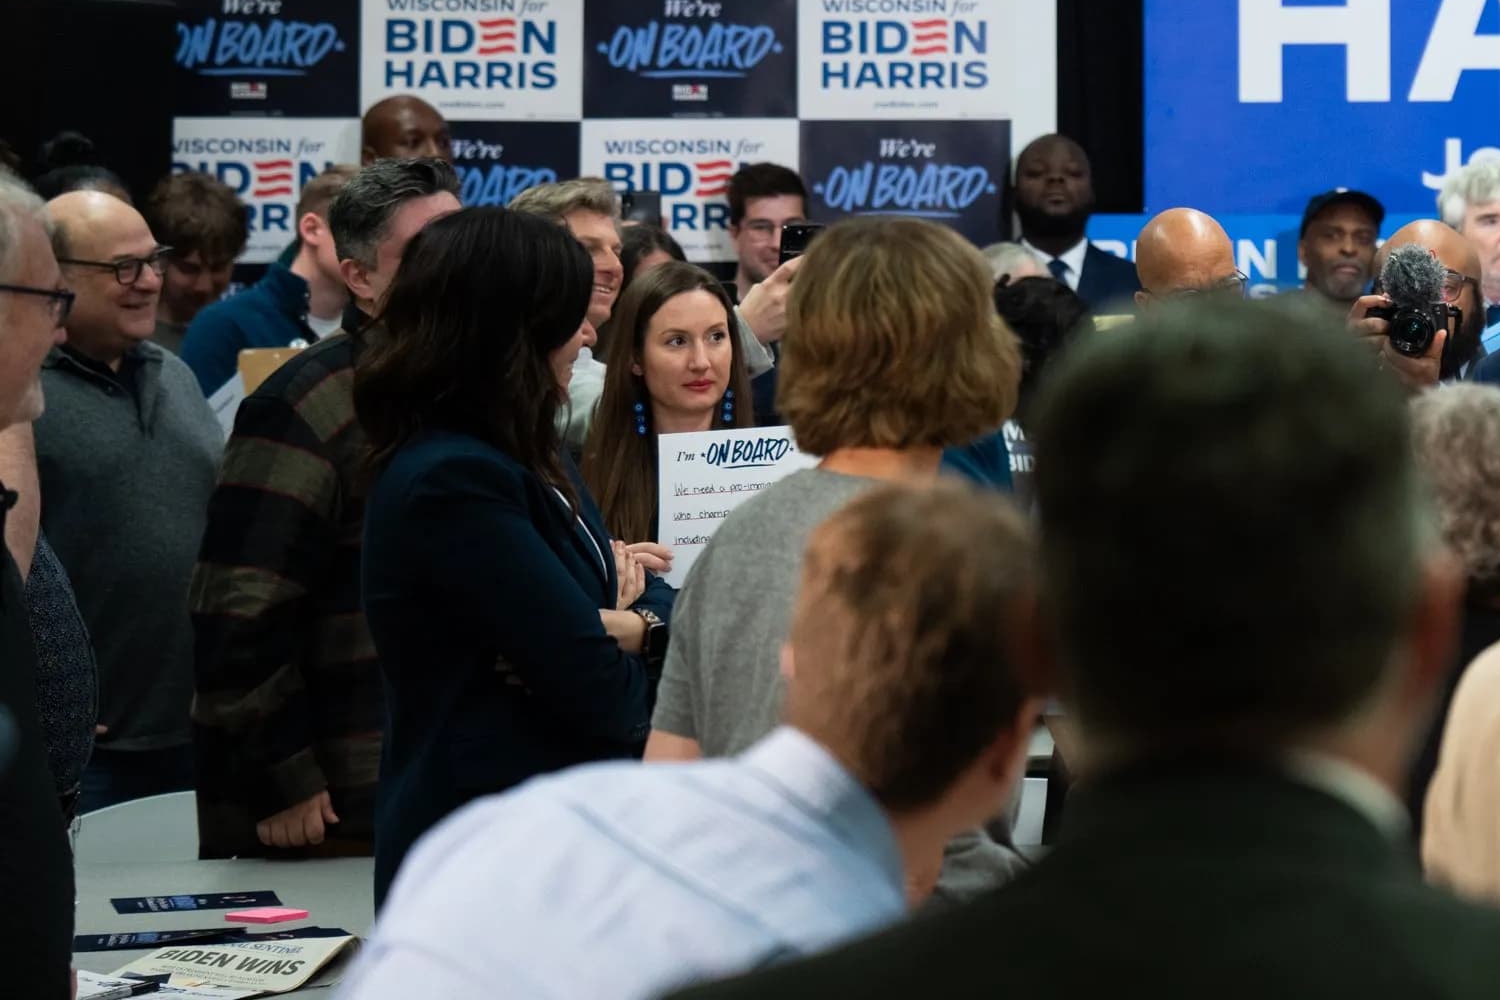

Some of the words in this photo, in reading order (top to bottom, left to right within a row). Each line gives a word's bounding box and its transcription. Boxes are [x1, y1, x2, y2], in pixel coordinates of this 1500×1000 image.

[386, 18, 556, 55] BIDEN
[822, 19, 986, 56] BIDEN
[385, 60, 556, 89] HARRIS
[822, 61, 988, 88] HARRIS
[880, 139, 936, 158] We're
[676, 450, 696, 463] I'm
[706, 439, 731, 467] ON
[731, 437, 790, 464] BOARD
[155, 949, 235, 967] BIDEN
[236, 956, 306, 975] WINS
